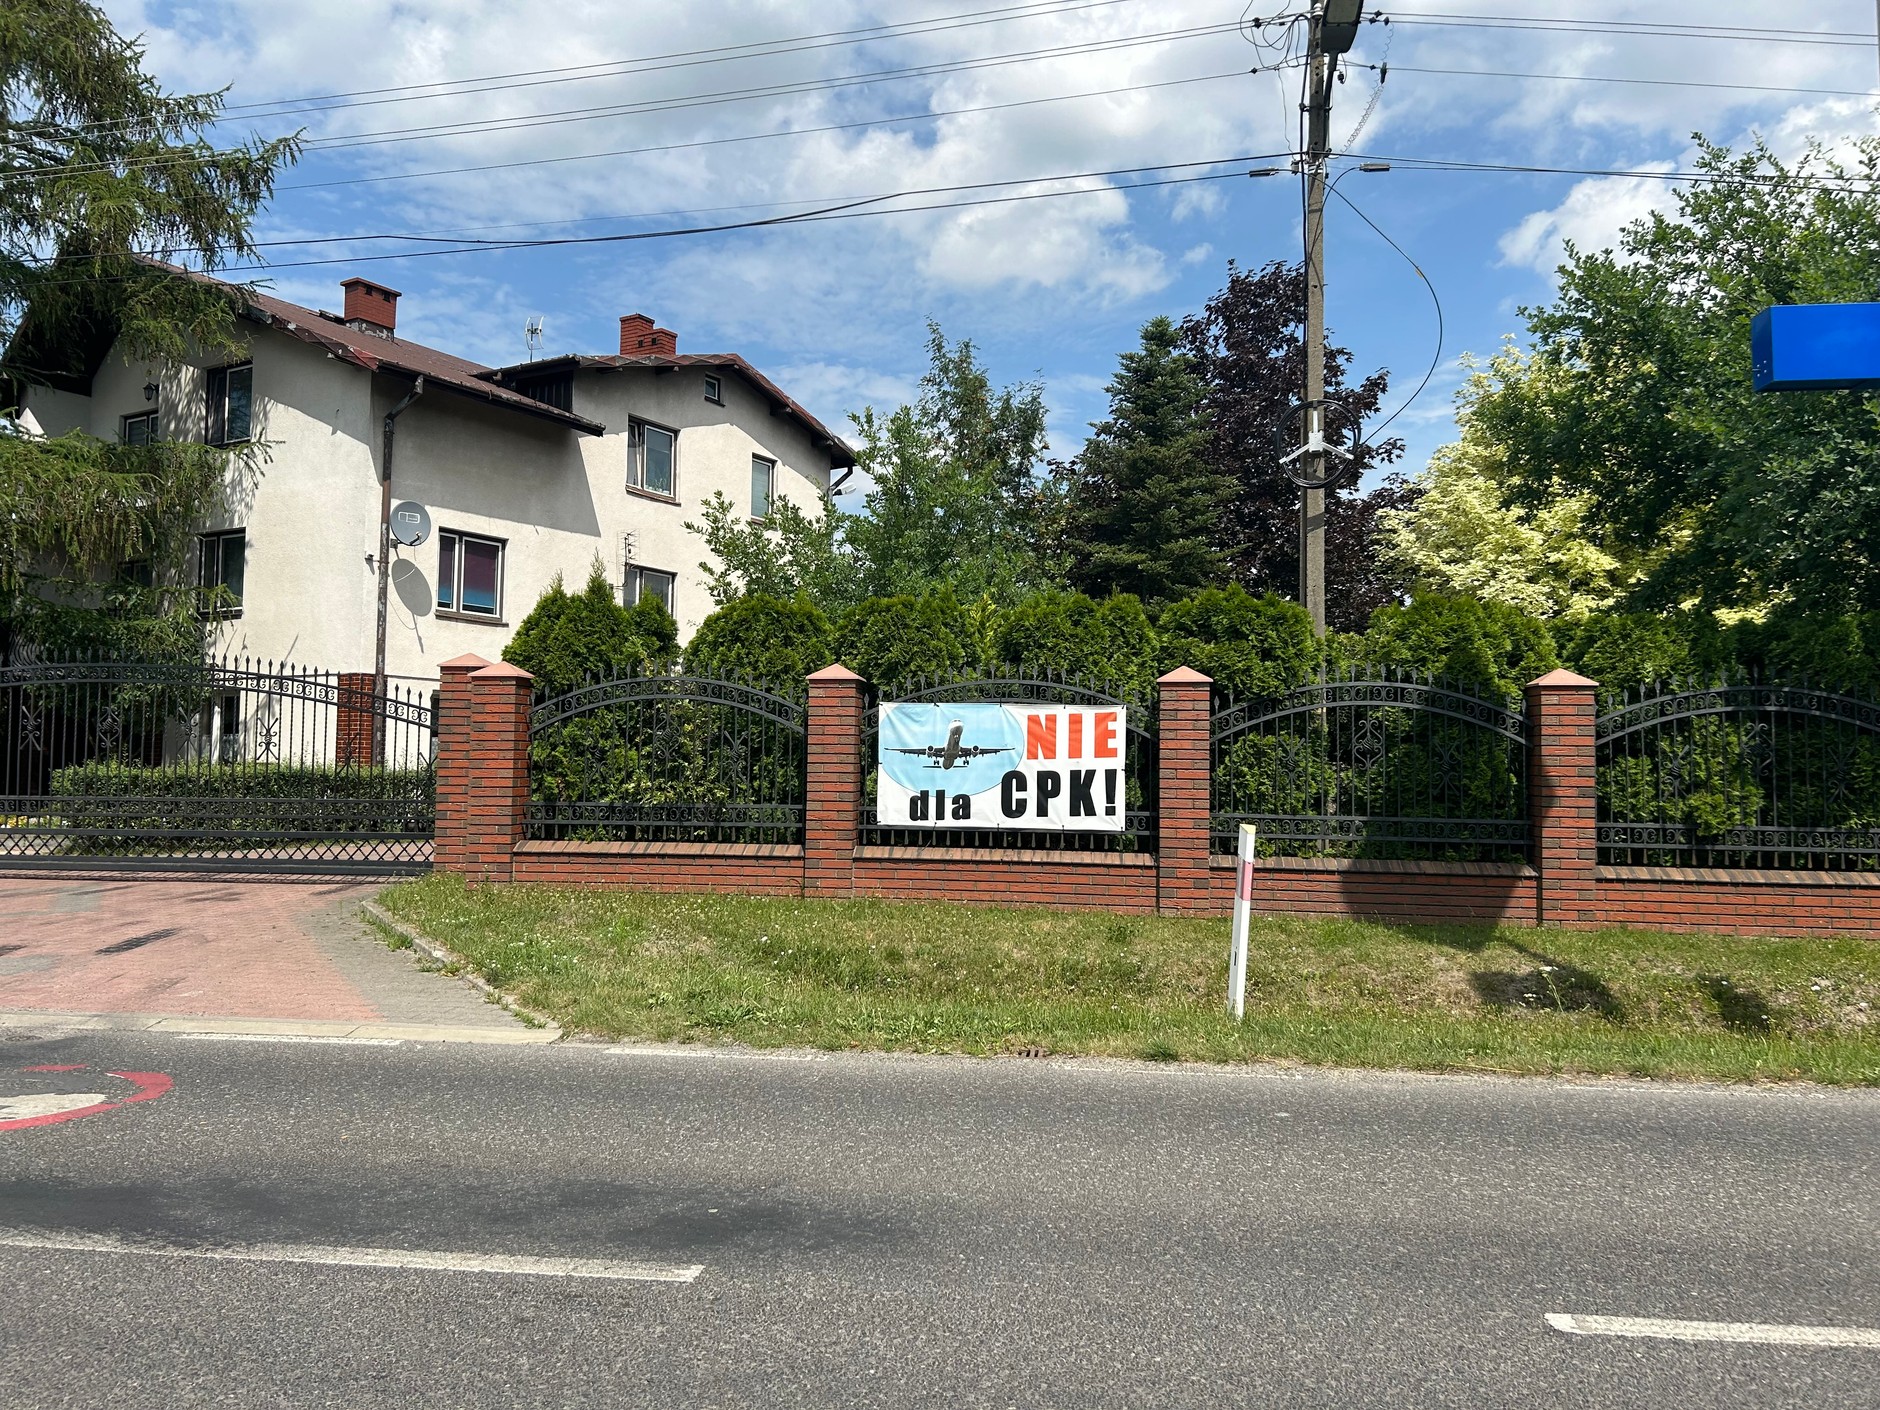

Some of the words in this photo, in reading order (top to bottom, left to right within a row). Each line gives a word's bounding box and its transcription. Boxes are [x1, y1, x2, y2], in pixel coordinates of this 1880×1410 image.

[1026, 712, 1118, 760] NIE
[909, 789, 971, 821] dla
[1000, 768, 1118, 819] CPK!
